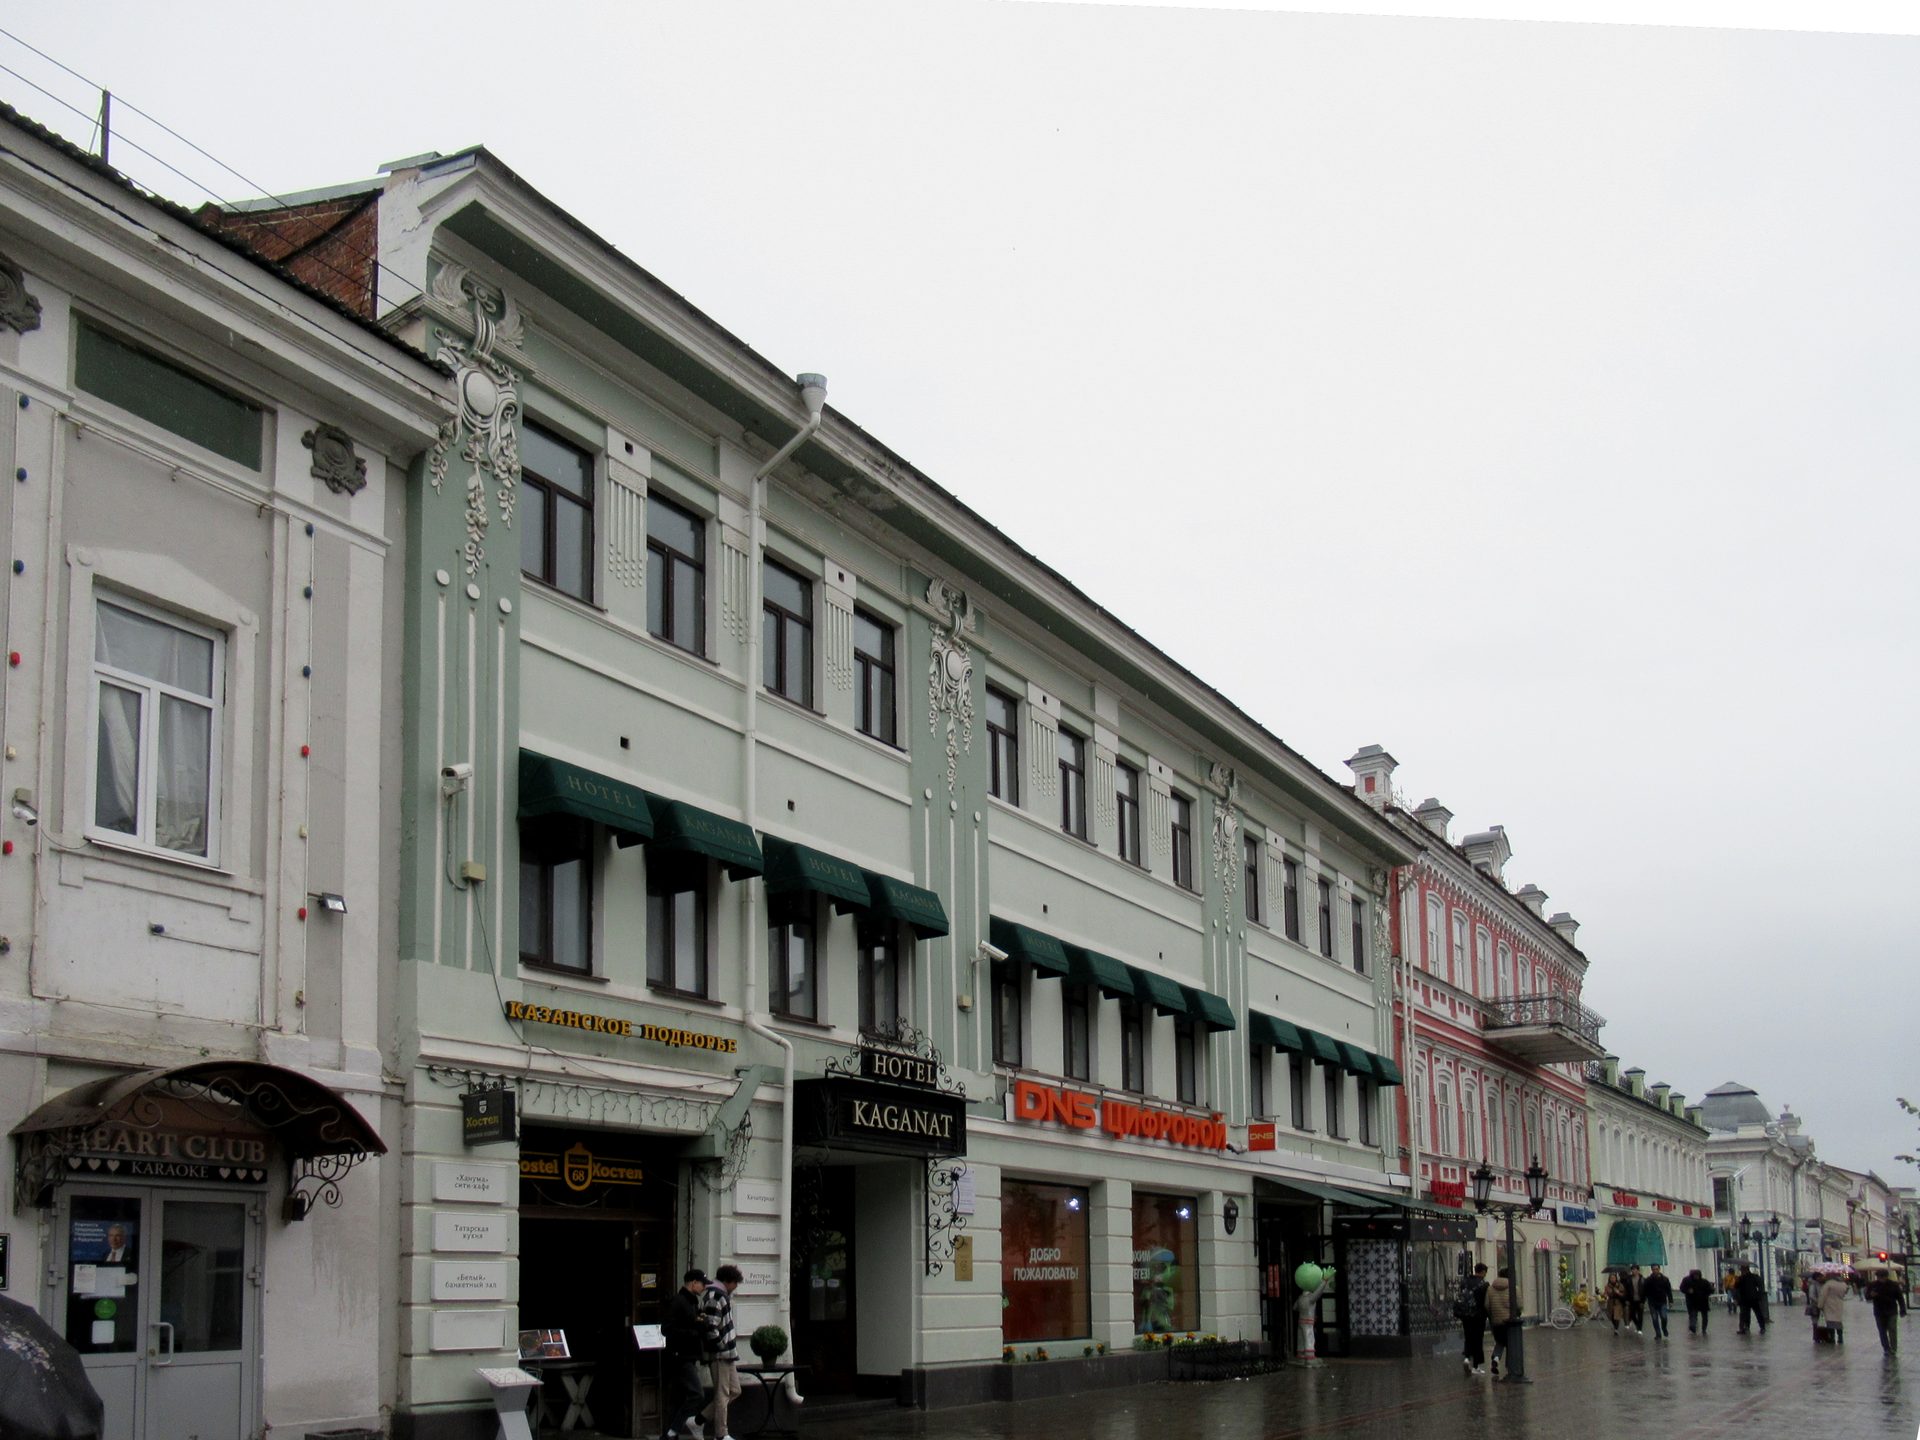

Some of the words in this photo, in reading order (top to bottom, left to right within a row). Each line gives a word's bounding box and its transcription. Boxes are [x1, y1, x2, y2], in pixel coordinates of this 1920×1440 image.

[568, 775, 636, 808] HOTEL
[808, 857, 858, 884] HOTEL
[507, 1000, 633, 1036] КАЗАНСКОЕ
[643, 1023, 738, 1053] ПОДВОРЬЕ
[873, 1053, 936, 1084] HOTEL
[466, 1115, 499, 1128] Хостел
[853, 1100, 953, 1138] KAGANAT
[1016, 1079, 1097, 1129] DNS
[1102, 1099, 1227, 1151] ЦИФРОВОЙ
[1249, 1131, 1274, 1141] DNS
[184, 1135, 266, 1163] CLUB
[131, 1160, 209, 1178] KARAOKE
[519, 1159, 559, 1174] ostel
[572, 1169, 585, 1182] 68
[592, 1162, 644, 1180] Хостел
[454, 1224, 489, 1233] Татарская
[1029, 1247, 1062, 1263] ДОБРО
[1013, 1267, 1079, 1281] ПОЖАЛОВАТЬ!
